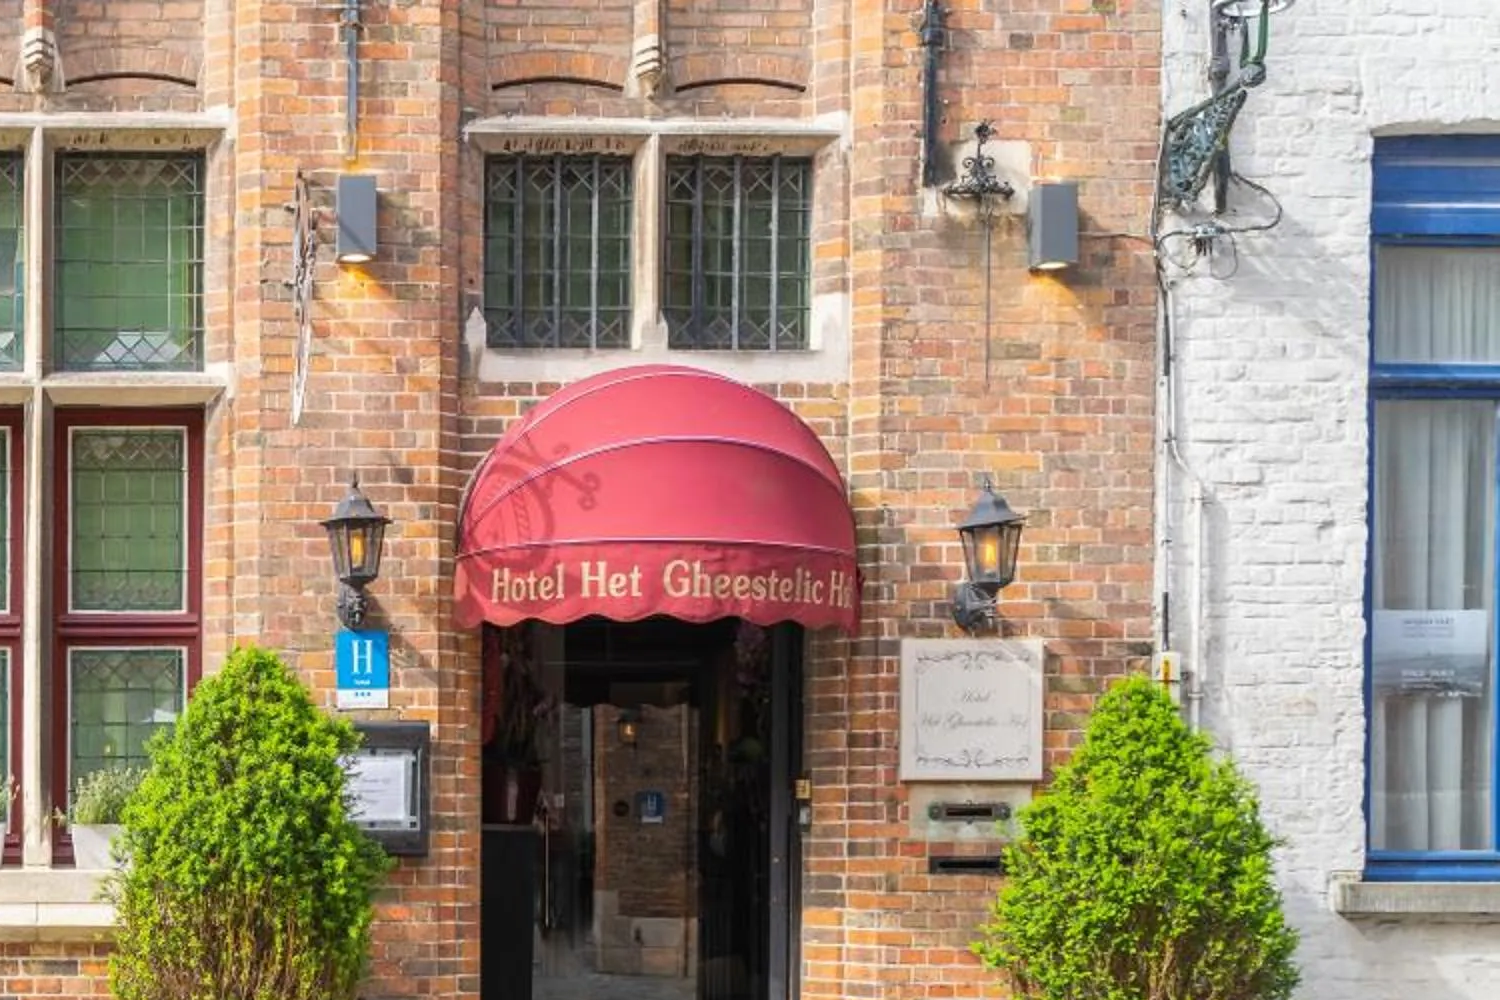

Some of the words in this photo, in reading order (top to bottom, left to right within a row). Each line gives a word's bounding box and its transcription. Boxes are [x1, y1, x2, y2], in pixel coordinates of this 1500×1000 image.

[492, 563, 564, 603] Hotel
[580, 560, 643, 598] Het
[663, 559, 824, 604] Gheestelic
[351, 639, 373, 675] H
